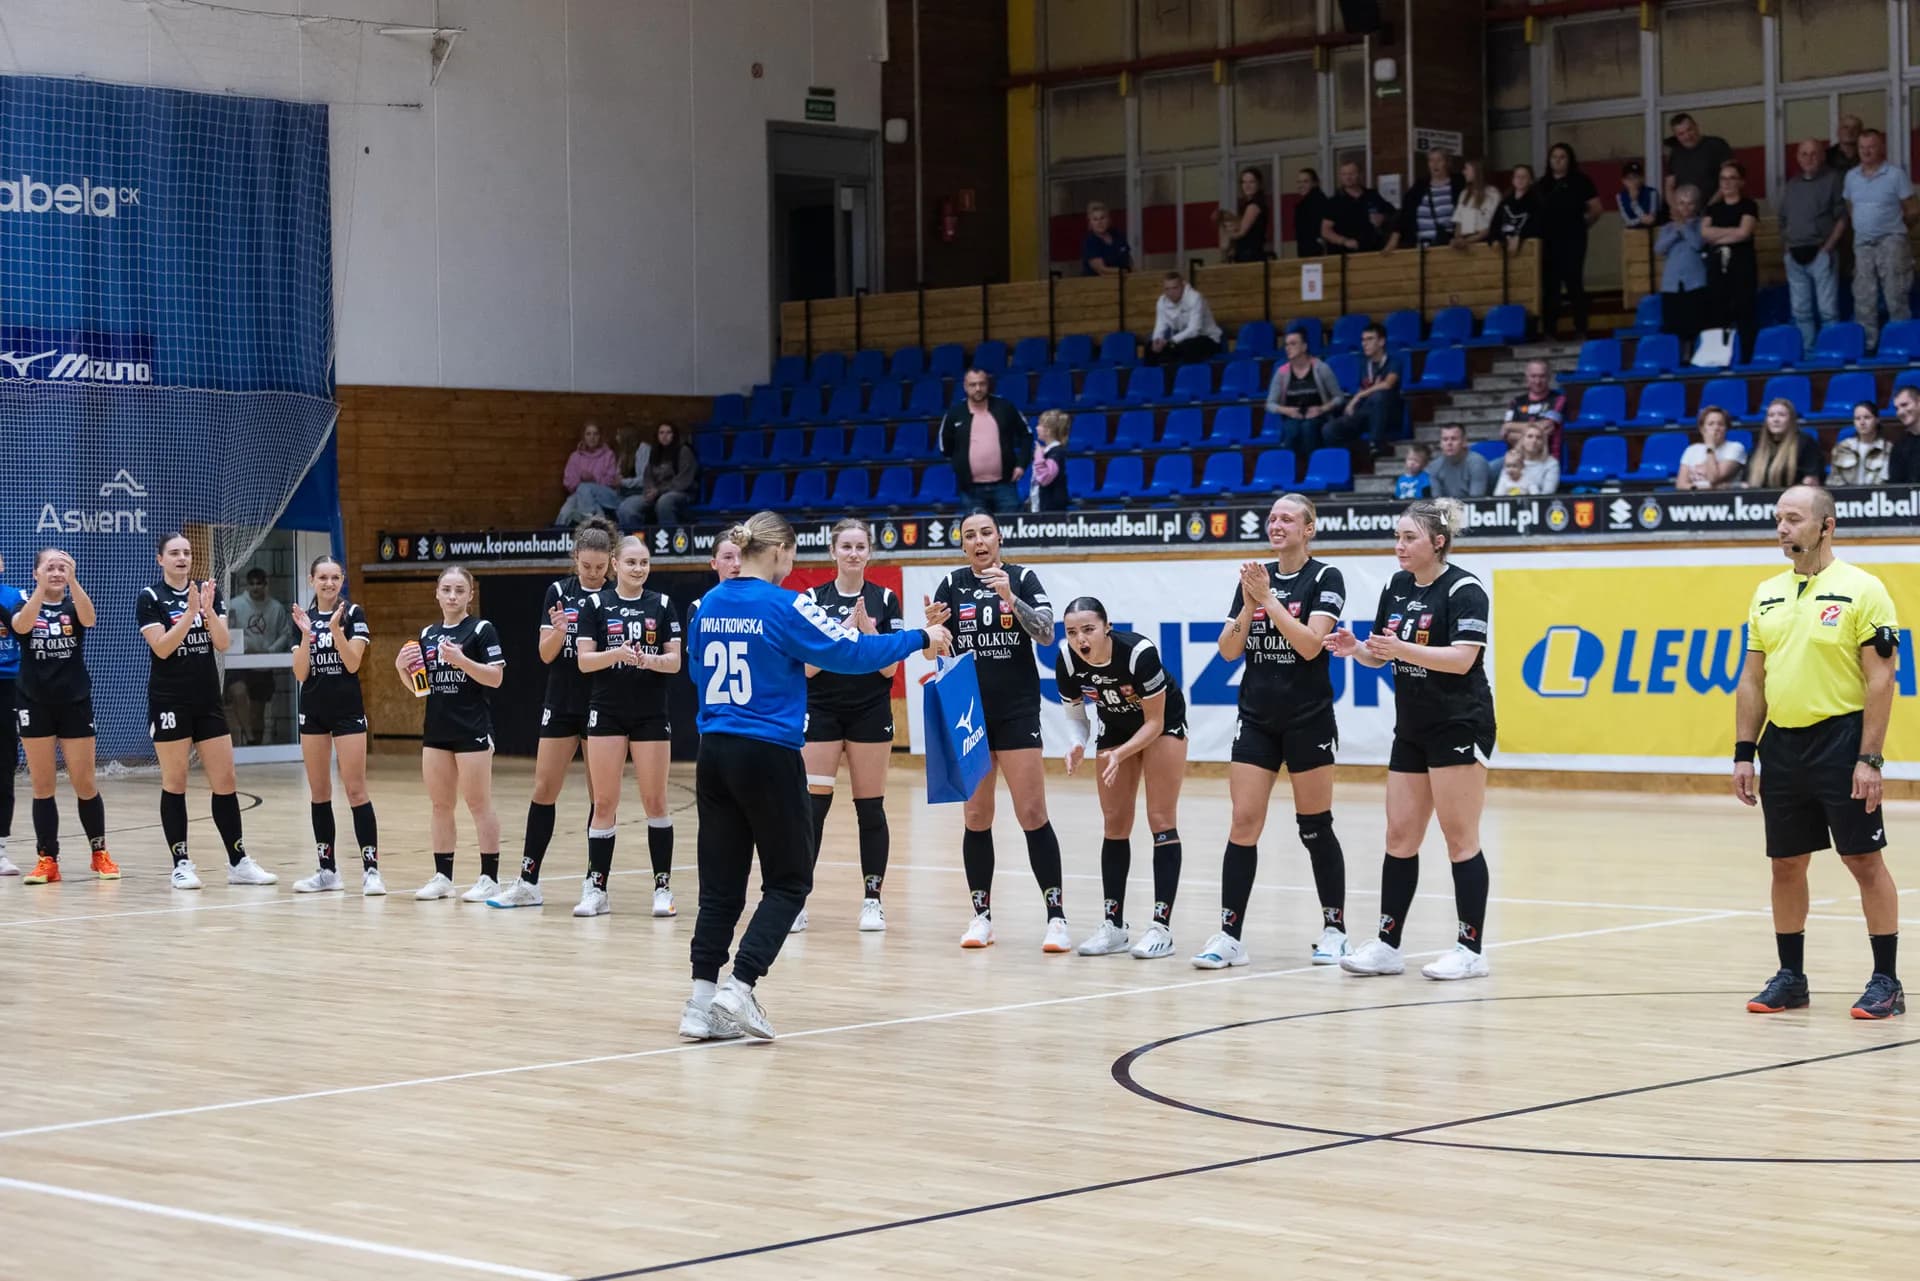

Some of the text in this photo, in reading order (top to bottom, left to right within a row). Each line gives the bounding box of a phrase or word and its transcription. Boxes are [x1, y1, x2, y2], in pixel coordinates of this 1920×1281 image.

[119, 187, 141, 205] CK
[36, 503, 147, 533] Aswent
[982, 605, 993, 626] 8
[627, 621, 643, 642] 19
[1401, 618, 1416, 640] 5
[957, 632, 1020, 649] SPR OLKUSZ
[435, 671, 467, 683] OLKUSZ
[703, 641, 752, 705] 25
[1102, 689, 1121, 705] 16
[160, 711, 177, 729] 28
